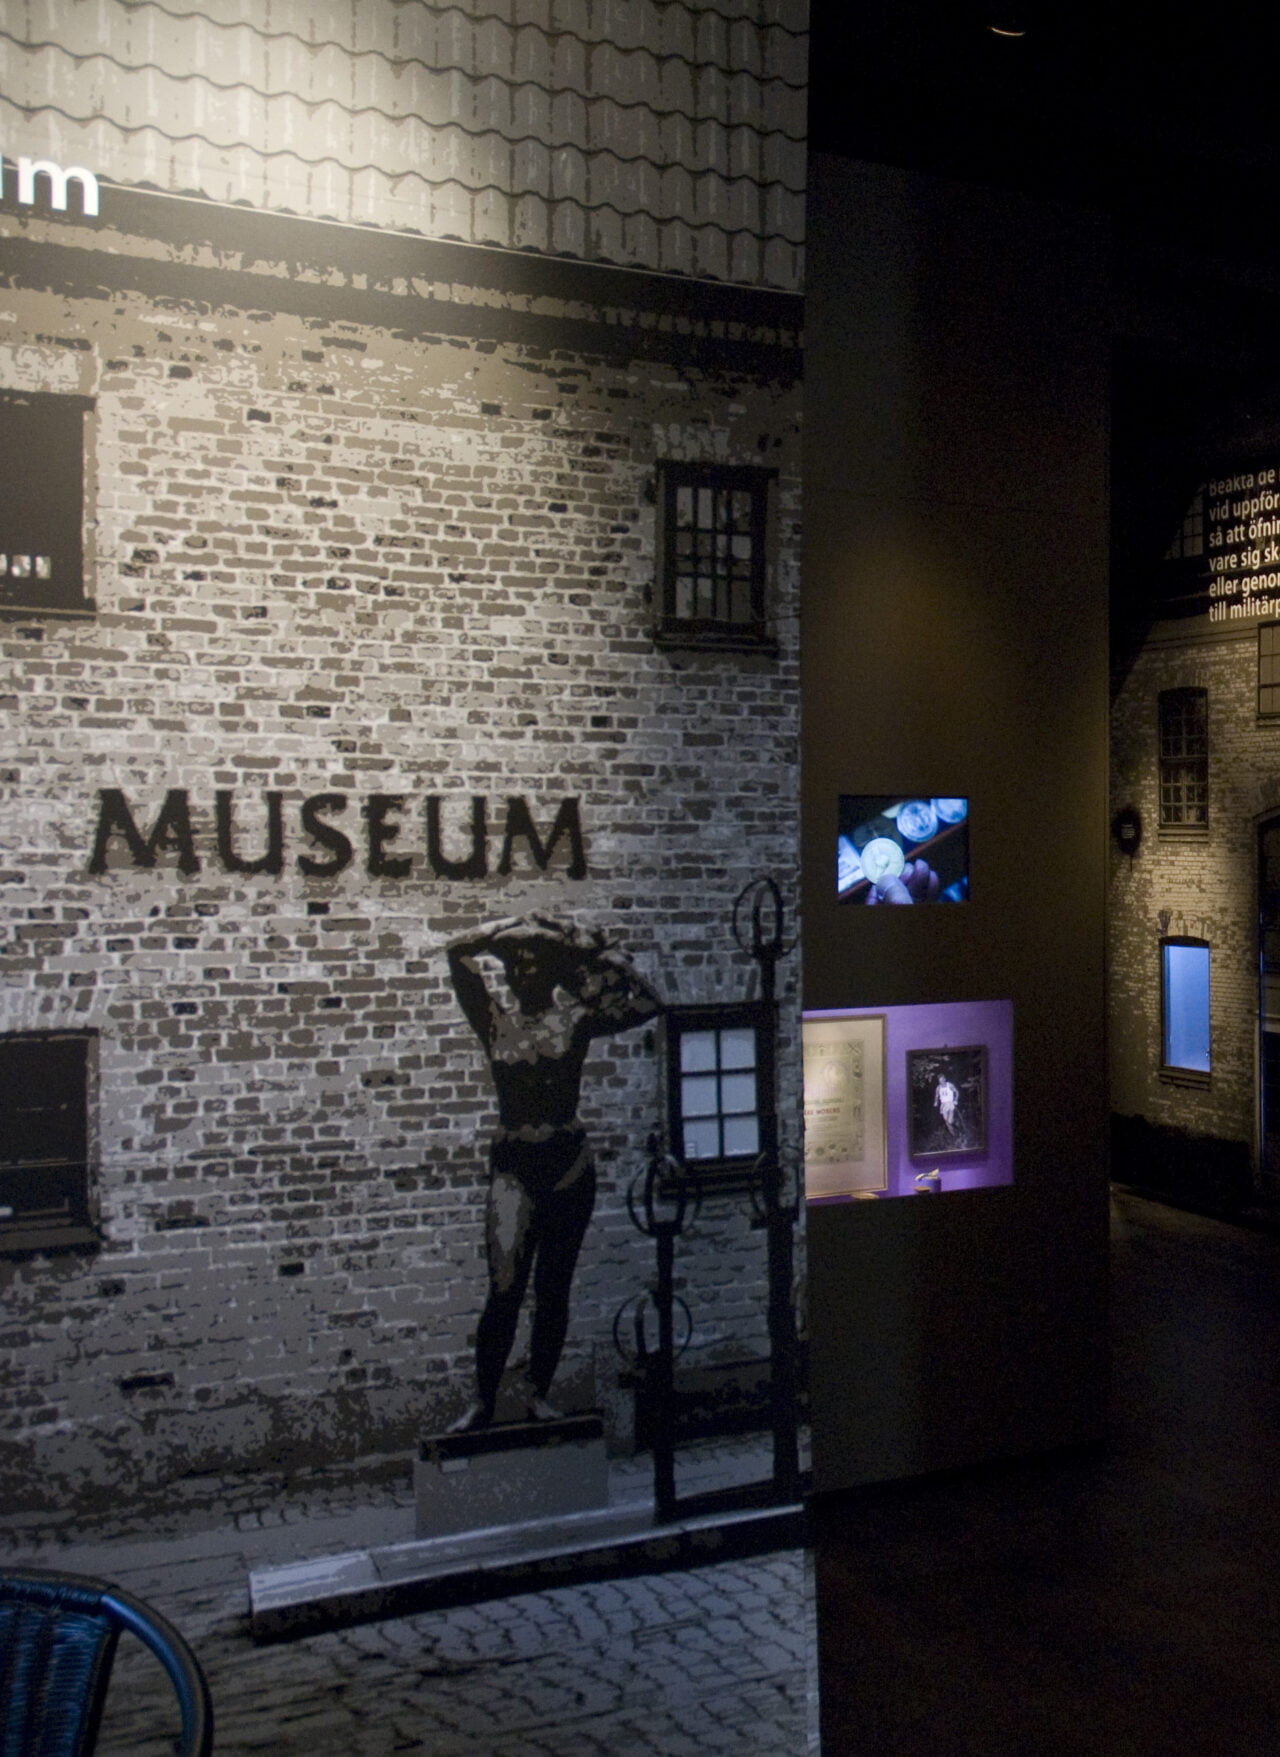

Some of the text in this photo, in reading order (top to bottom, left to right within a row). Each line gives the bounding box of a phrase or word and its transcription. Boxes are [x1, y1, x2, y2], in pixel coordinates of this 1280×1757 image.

[0, 152, 99, 217] m
[1209, 472, 1254, 497] Beakta
[1258, 467, 1275, 486] de
[1209, 499, 1229, 522] vid
[1209, 526, 1223, 548] så
[1226, 524, 1245, 544] att
[1208, 553, 1241, 572] vare
[1241, 546, 1260, 570] sig
[1208, 575, 1239, 597] eller
[1208, 601, 1226, 622] till
[88, 787, 587, 881] MUSEUM
